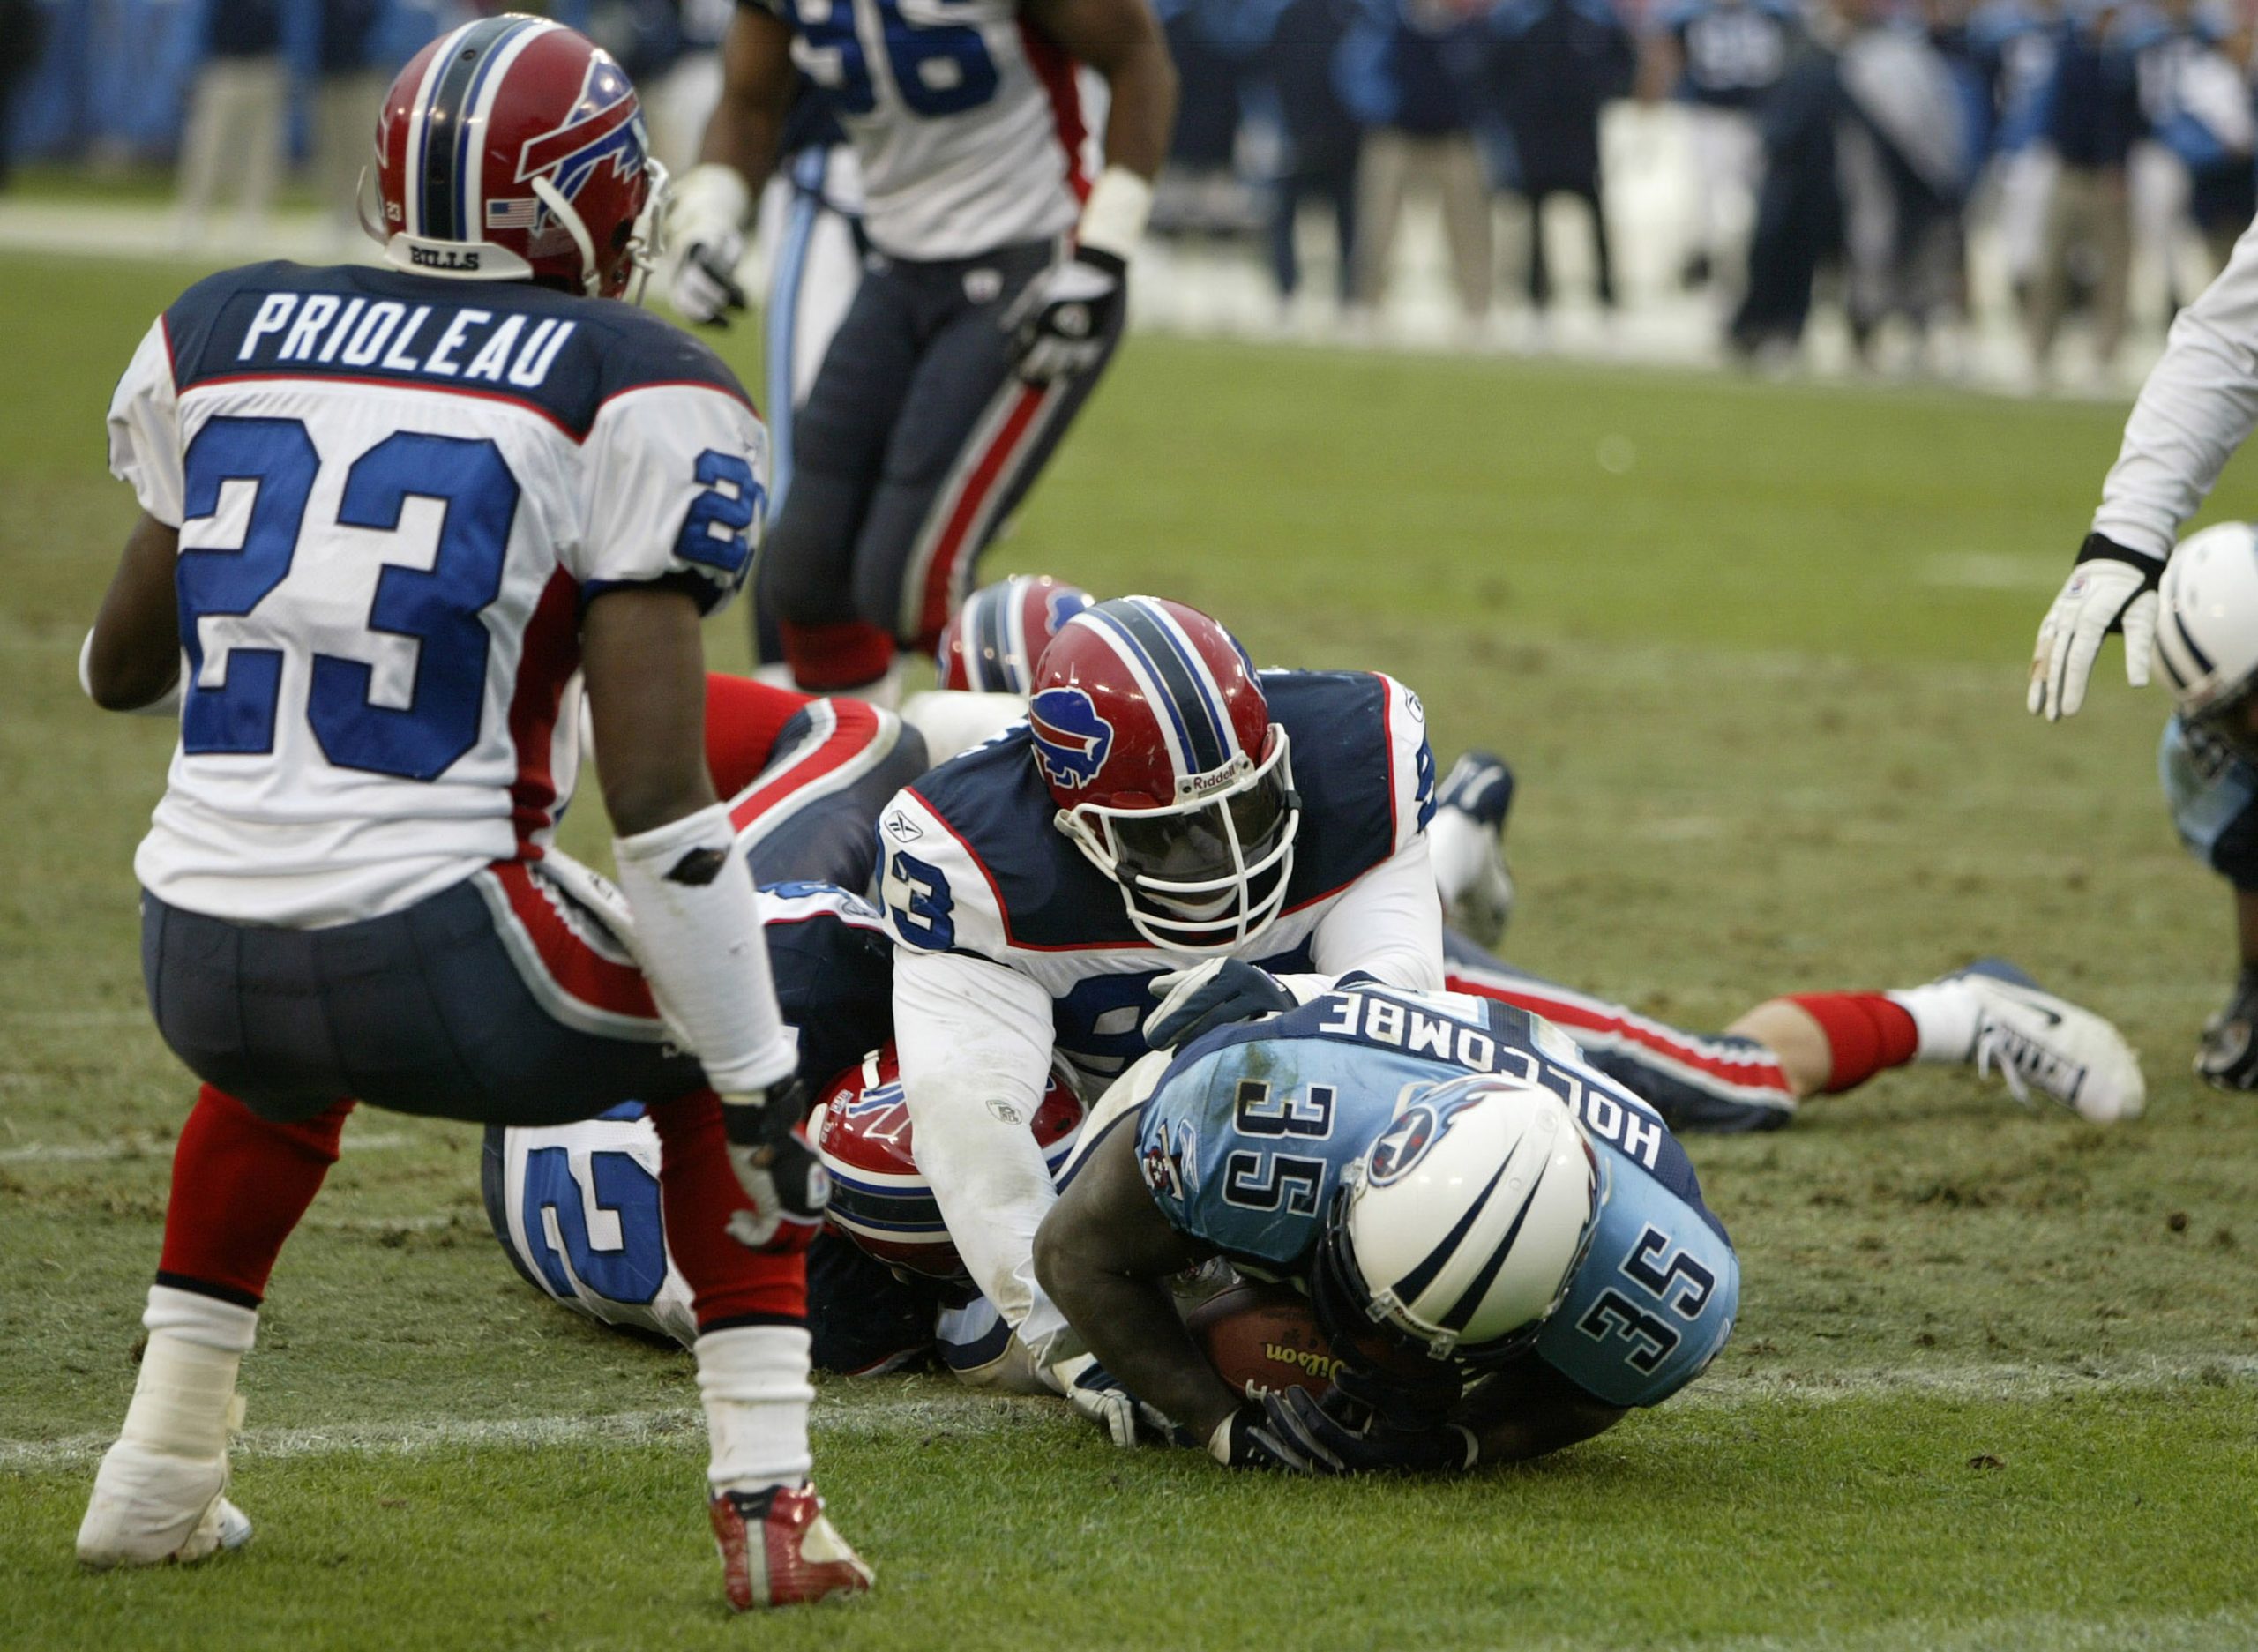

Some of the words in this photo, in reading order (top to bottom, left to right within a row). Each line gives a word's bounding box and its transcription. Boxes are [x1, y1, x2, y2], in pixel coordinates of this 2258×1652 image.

[409, 244, 480, 272] BILLS
[236, 291, 578, 390] PRIOLEAU
[671, 447, 768, 592] 2
[176, 414, 522, 784] 23
[1193, 763, 1236, 790] Riddell
[873, 817, 956, 952] 3
[1222, 1077, 1339, 1219] 35
[1319, 991, 1662, 1170] HOLCOMBE
[523, 1100, 669, 1306] 2
[1574, 1219, 1718, 1378] 35
